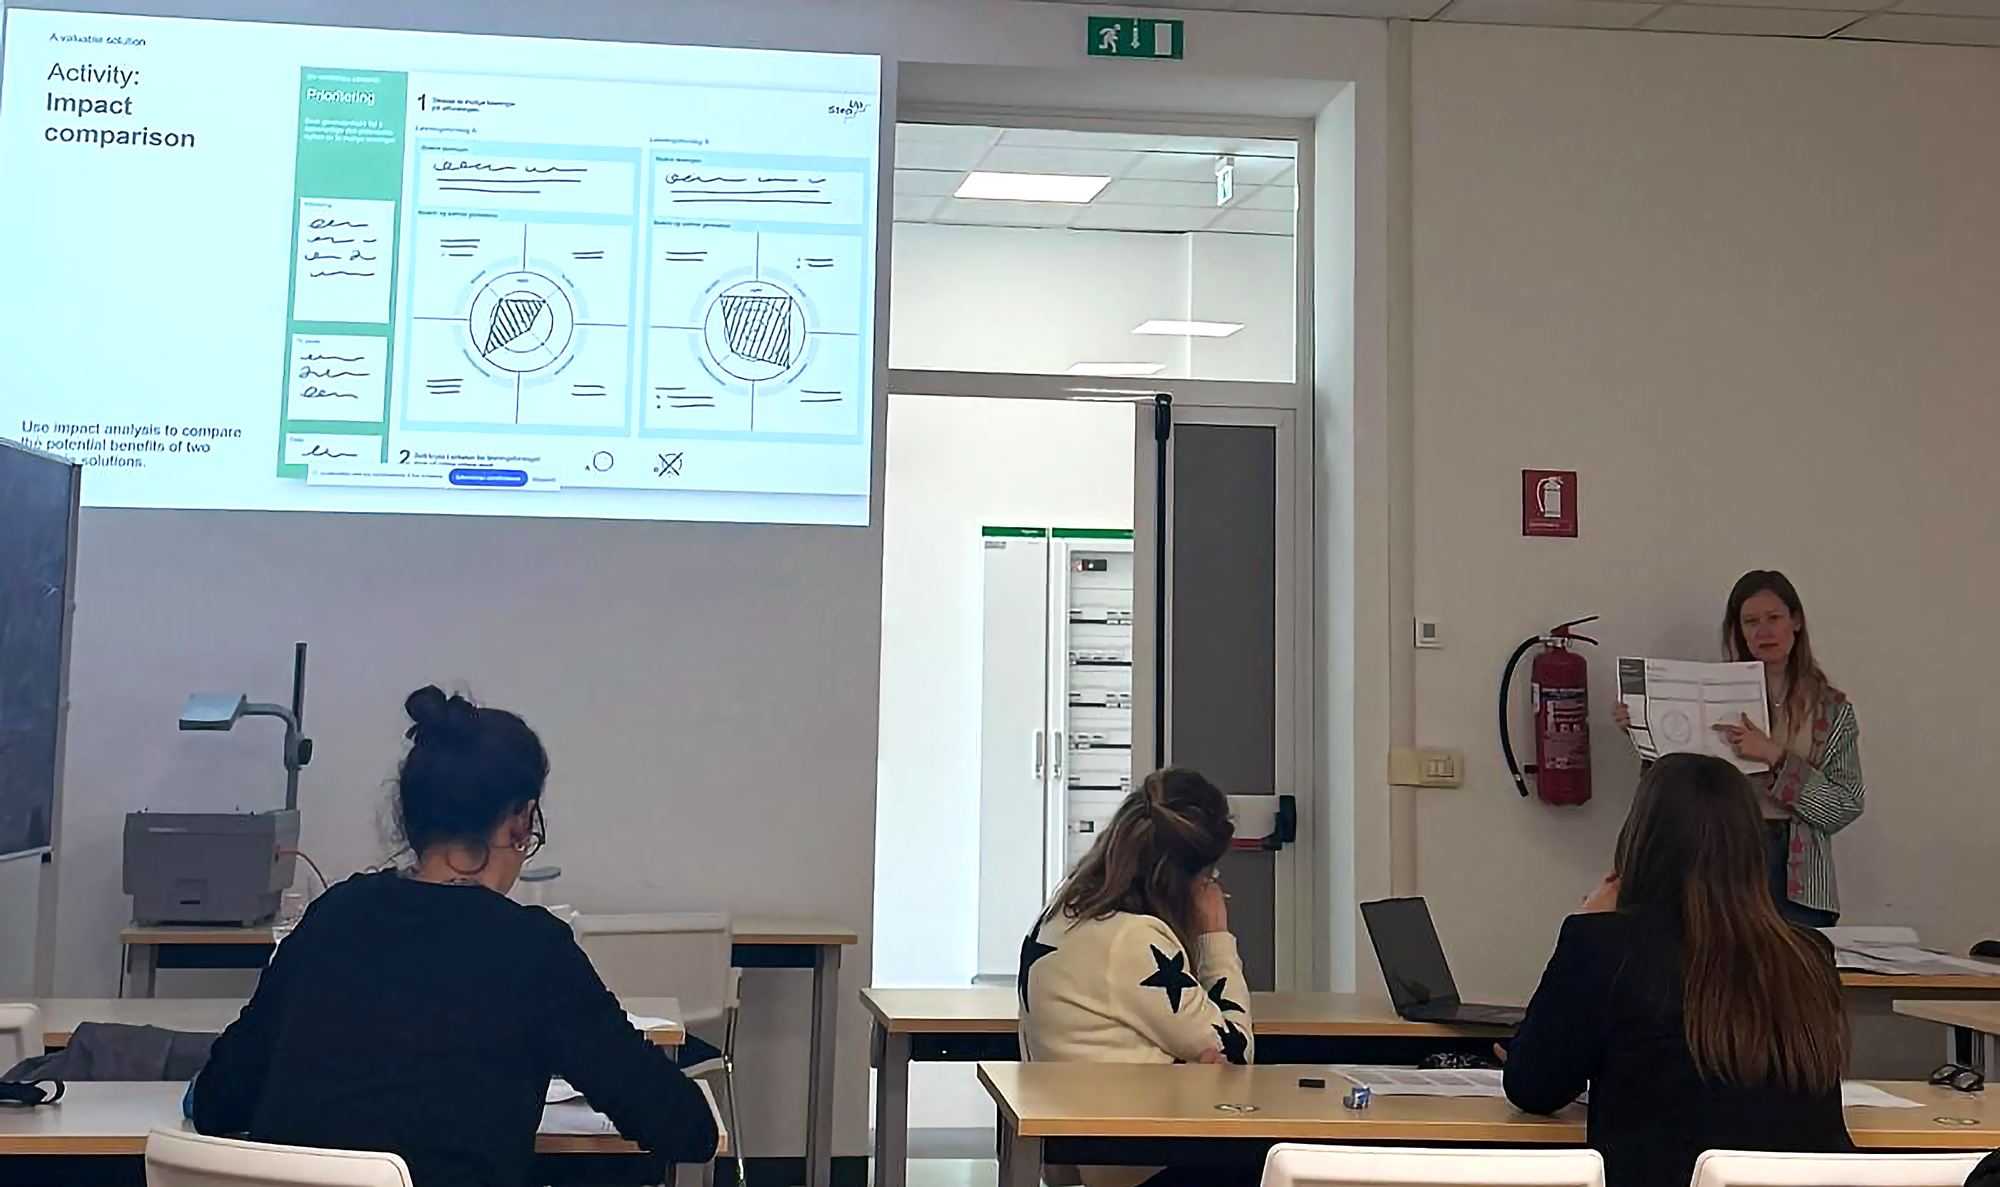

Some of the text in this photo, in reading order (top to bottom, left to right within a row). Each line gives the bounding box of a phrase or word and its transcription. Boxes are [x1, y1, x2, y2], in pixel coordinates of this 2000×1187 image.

[47, 62, 140, 89] Activity:
[46, 92, 133, 117] Impact
[417, 93, 426, 111] 1
[44, 126, 196, 149] comparison
[22, 420, 242, 440] Use impact analysis to compare
[46, 438, 106, 451] potential
[110, 439, 165, 452] benefits
[169, 440, 182, 453] of
[186, 442, 211, 453] two
[81, 454, 147, 468] solutions.
[398, 449, 411, 464] 2
